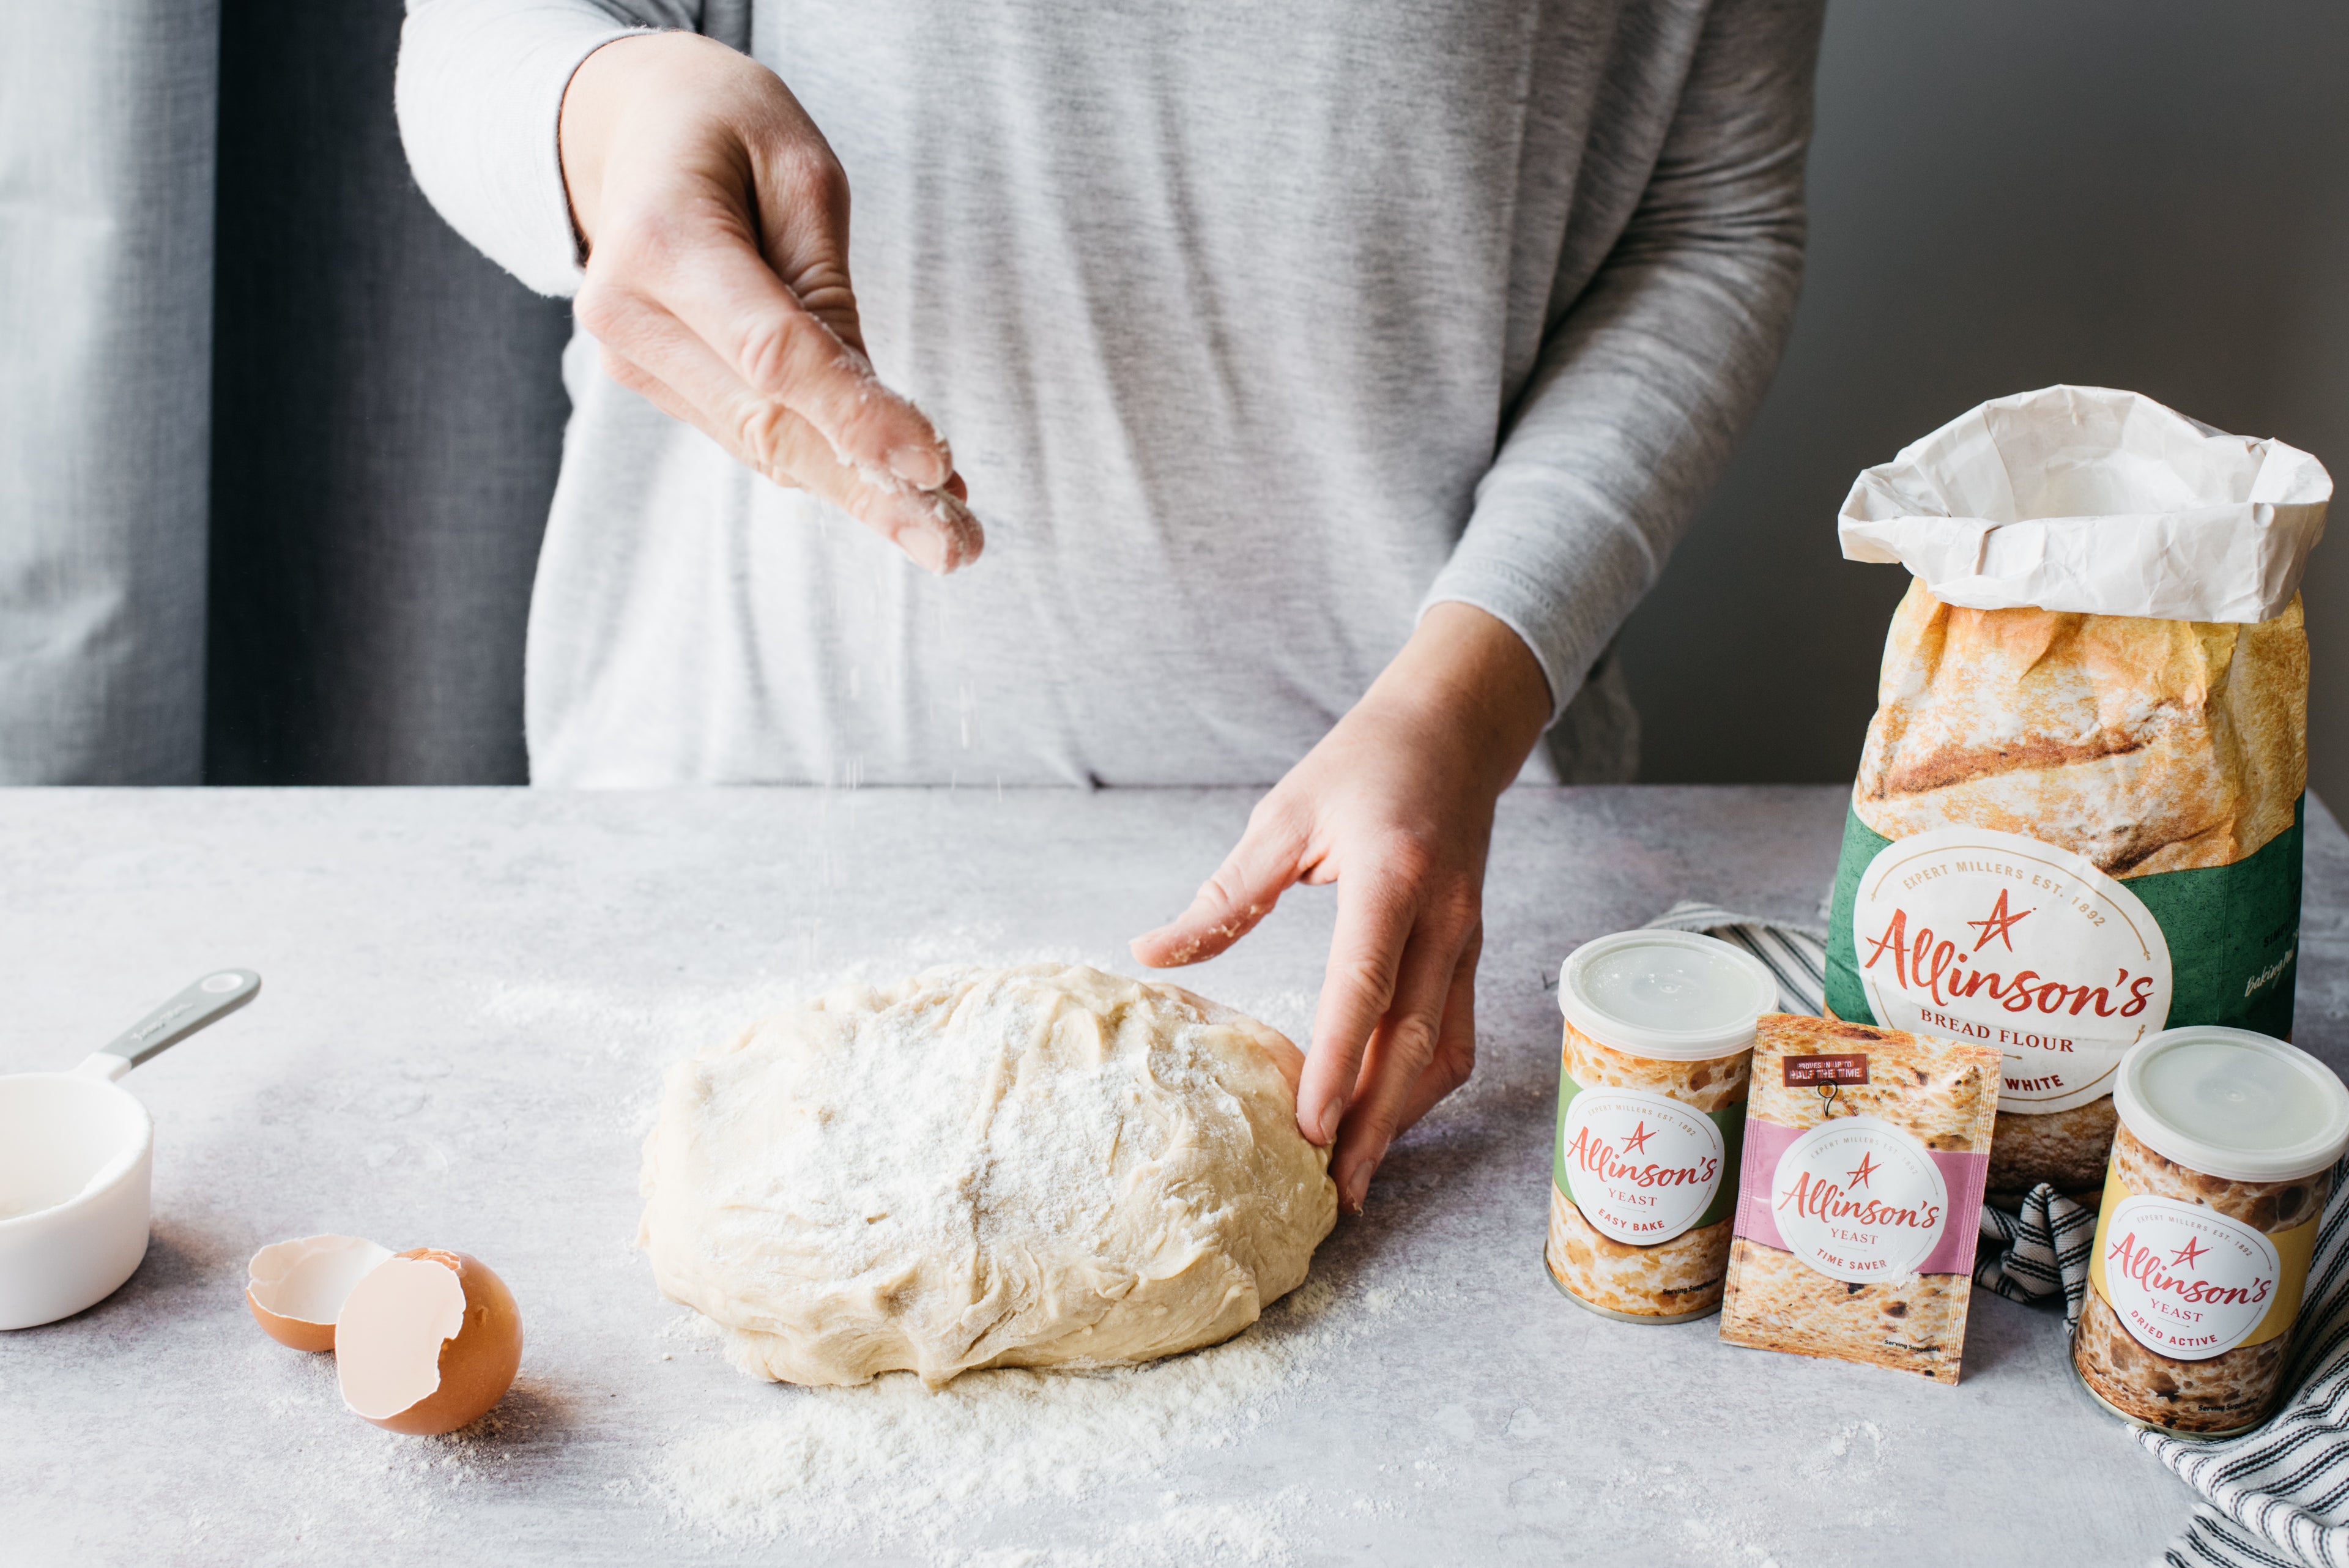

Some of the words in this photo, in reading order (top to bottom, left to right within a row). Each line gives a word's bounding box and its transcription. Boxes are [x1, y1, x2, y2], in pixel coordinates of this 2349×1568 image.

[1903, 864, 1948, 890] EXPERT
[1956, 861, 2024, 880] MILLERS
[2032, 874, 2063, 897] EST.
[2071, 896, 2106, 927] 1892
[1865, 908, 2154, 1017] Allinson's
[1921, 1008, 1991, 1039] BREAD
[1999, 1028, 2074, 1053] FLOUR
[1789, 1069, 1814, 1080] HALF
[1816, 1069, 1835, 1079] THE
[1838, 1068, 1861, 1078] TIME
[2005, 1074, 2065, 1092] WHITE
[1587, 1104, 1611, 1116] EXPERT
[1616, 1104, 1653, 1115] MILLERS
[1657, 1112, 1674, 1123] EST.
[1678, 1121, 1696, 1137] 1892
[1567, 1126, 1718, 1187] Allinson's
[1810, 1140, 1839, 1159] EXPERT
[1843, 1137, 1880, 1146] MILLERS
[1901, 1157, 1918, 1175] 1892
[1608, 1187, 1658, 1206] YEAST
[1777, 1171, 1940, 1228] Allinson's
[1598, 1208, 1627, 1228] EASY
[1633, 1220, 1665, 1232] BAKE
[1830, 1228, 1879, 1244] YEAST
[2137, 1214, 2163, 1224] EXPERT
[2169, 1216, 2208, 1232] MILLERS
[2213, 1229, 2230, 1243] EST.
[2234, 1241, 2253, 1257] 1892
[1817, 1248, 1843, 1267] TIME
[1849, 1259, 1887, 1271] SAVER
[2108, 1232, 2272, 1305] Allinson's
[2151, 1298, 2203, 1322] YEAST
[2131, 1310, 2163, 1339] DRIED
[2169, 1334, 2217, 1346] ACTIVE
[1884, 1339, 1907, 1350] Serving
[1909, 1345, 1941, 1353] Suggestion
